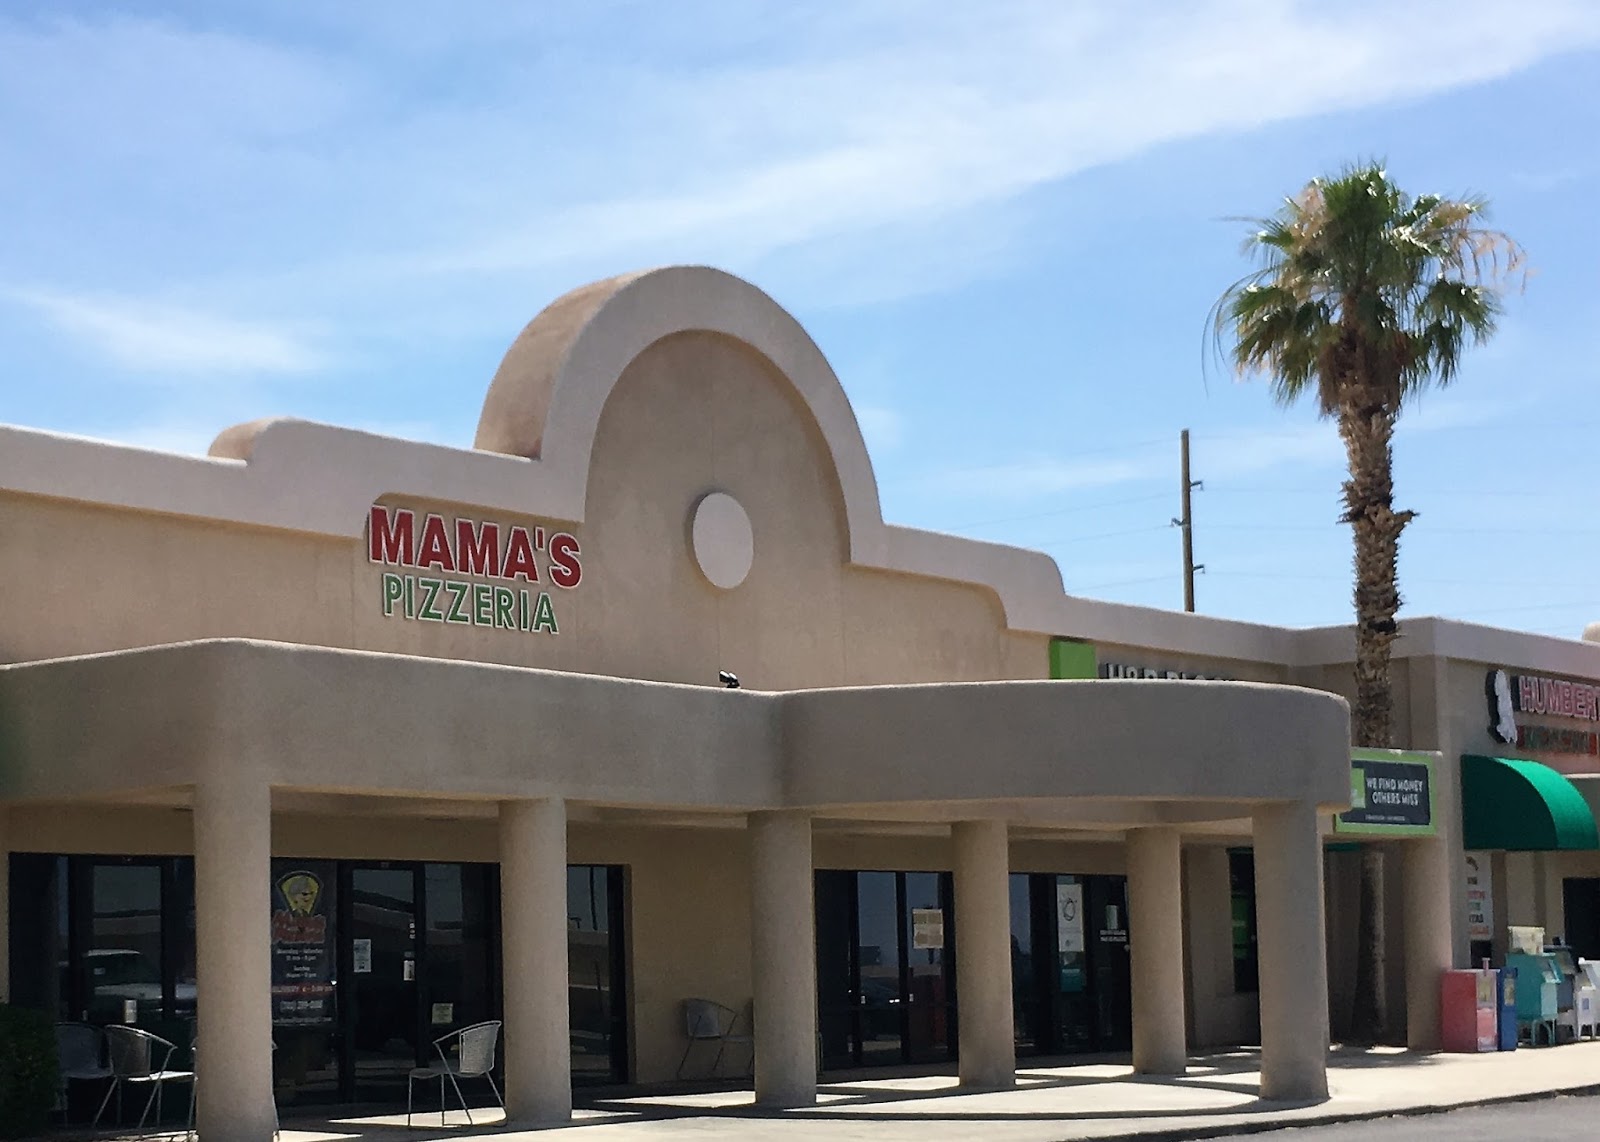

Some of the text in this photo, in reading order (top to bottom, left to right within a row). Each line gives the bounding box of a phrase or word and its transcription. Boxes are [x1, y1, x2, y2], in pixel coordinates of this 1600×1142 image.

[369, 505, 582, 589] MAMA'S
[382, 572, 559, 634] PIZZERIA
[1372, 791, 1400, 805] OTHERS
[1378, 777, 1396, 791] FIND
[1397, 779, 1423, 792] MONEY
